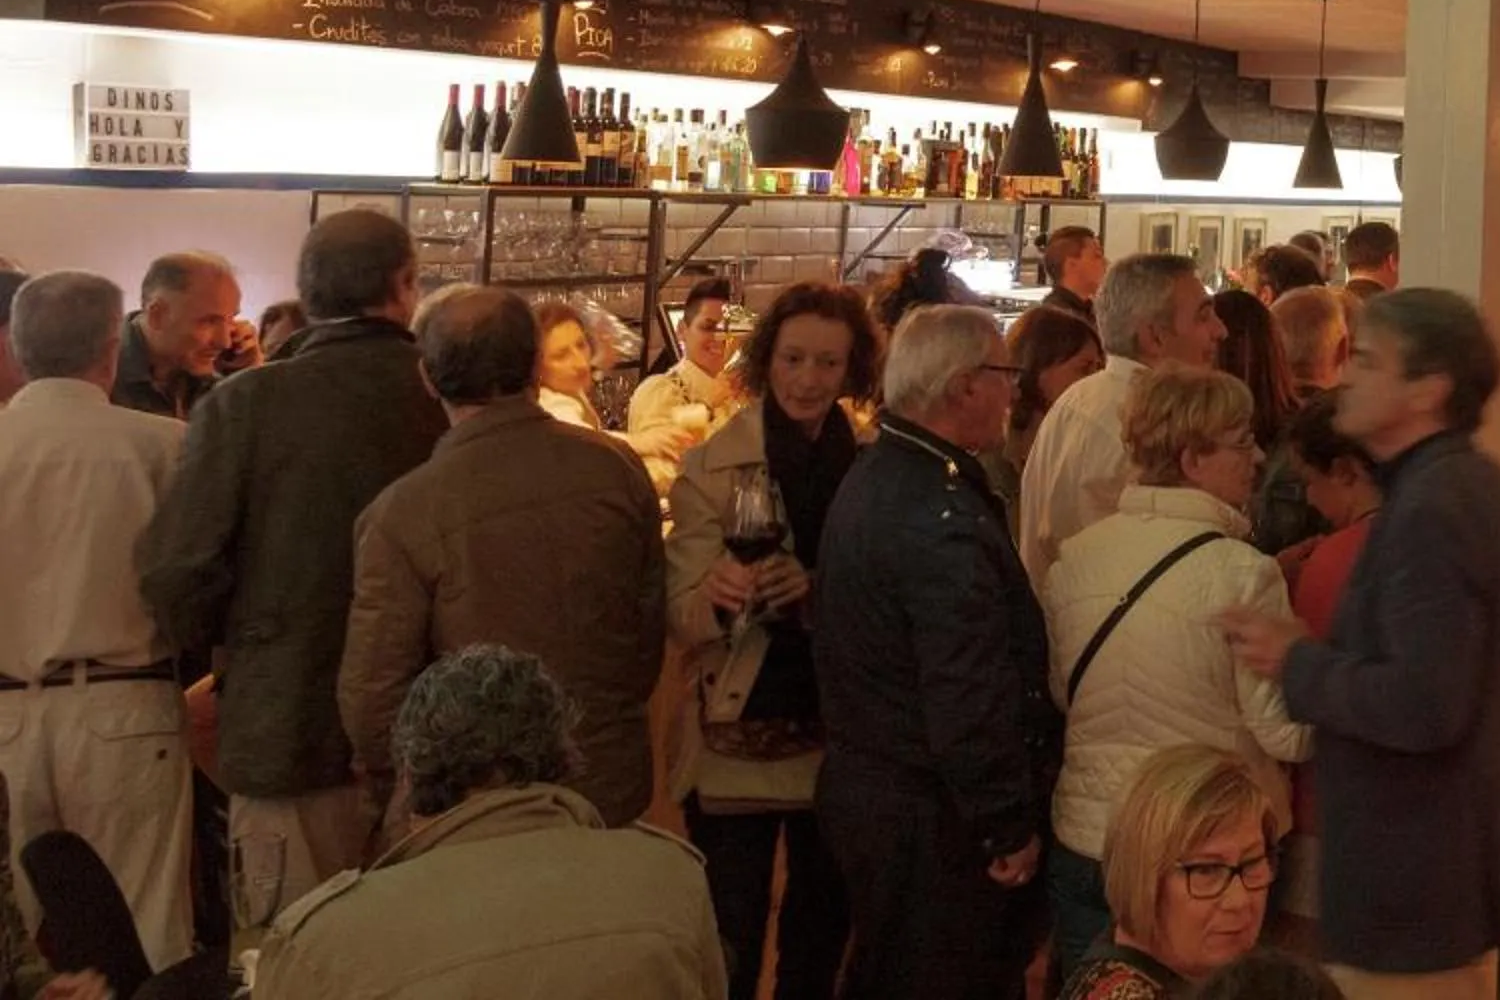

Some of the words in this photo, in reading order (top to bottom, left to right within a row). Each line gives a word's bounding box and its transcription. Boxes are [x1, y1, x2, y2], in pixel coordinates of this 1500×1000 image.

[108, 87, 173, 111] DINOS
[90, 113, 143, 137] HOLA
[175, 119, 183, 138] Y
[93, 143, 189, 165] GRACIAS
